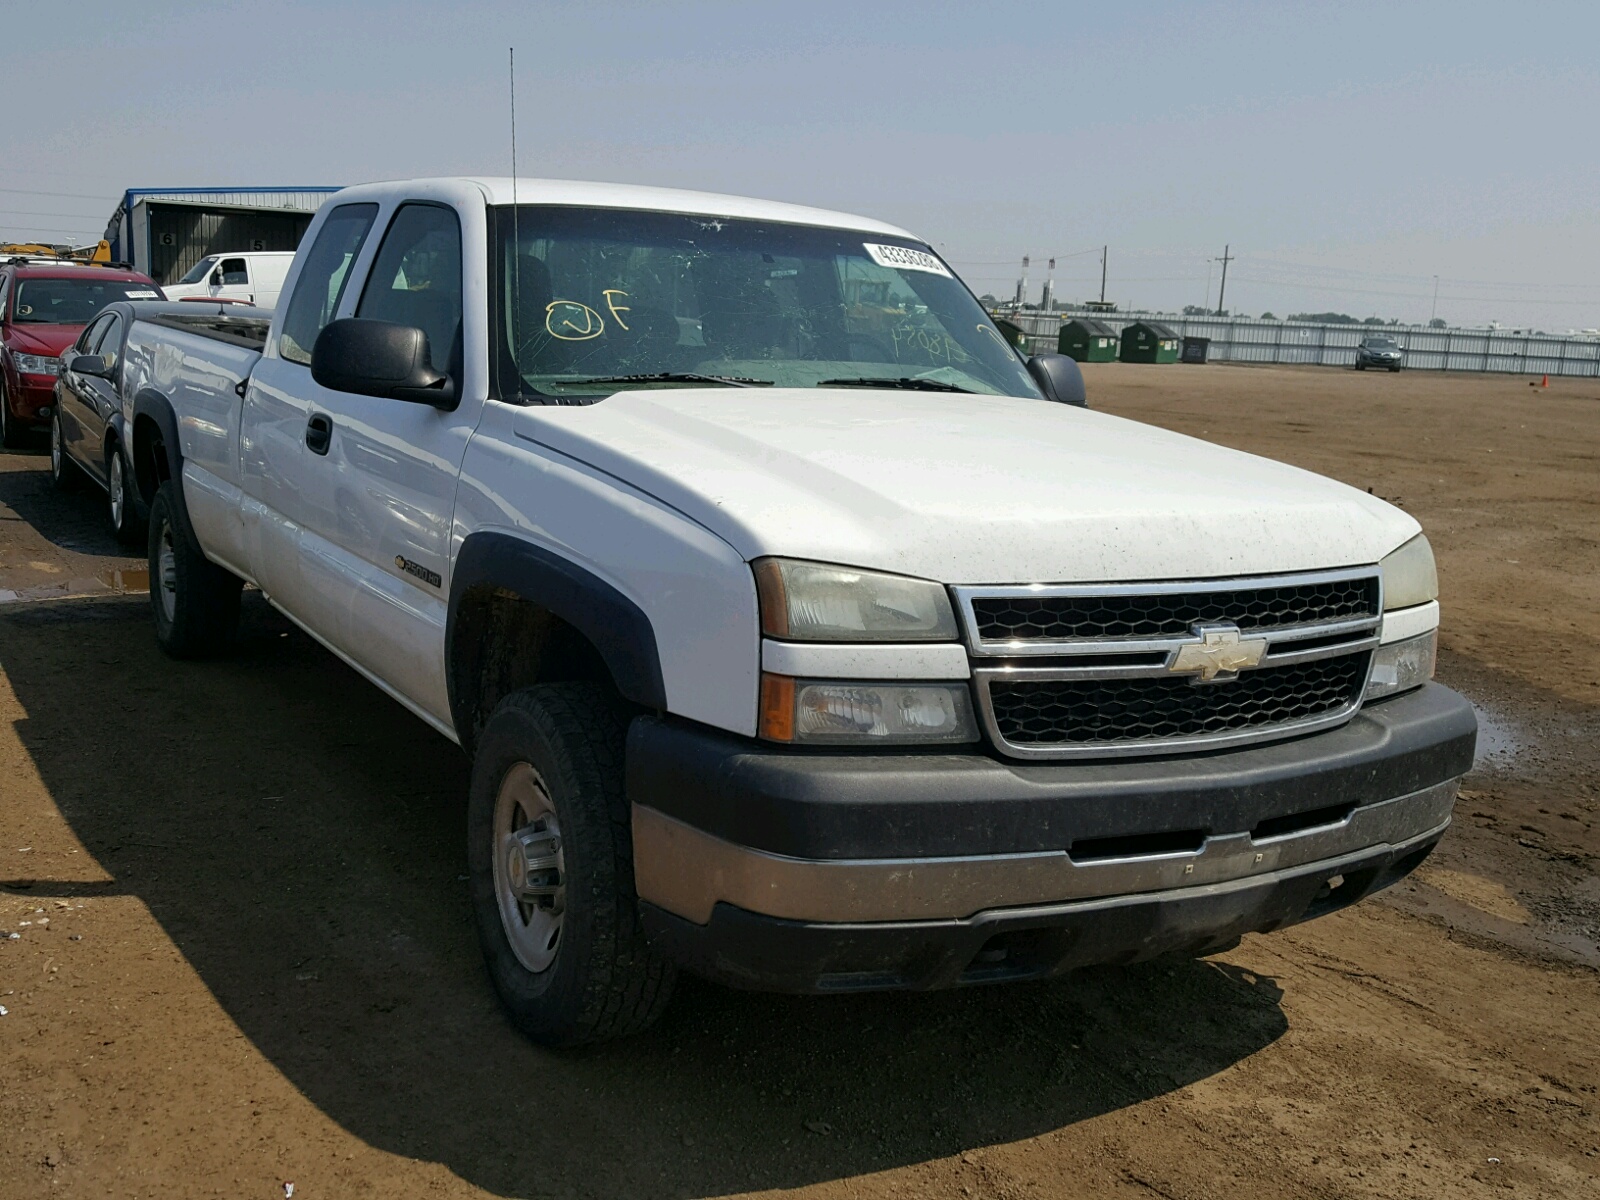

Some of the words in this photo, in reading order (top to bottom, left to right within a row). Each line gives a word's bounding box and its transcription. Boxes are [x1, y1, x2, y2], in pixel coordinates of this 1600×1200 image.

[163, 233, 172, 245] 6
[254, 240, 263, 251] 5
[602, 289, 631, 331] F
[405, 560, 428, 581] 2500
[428, 573, 439, 586] HD
